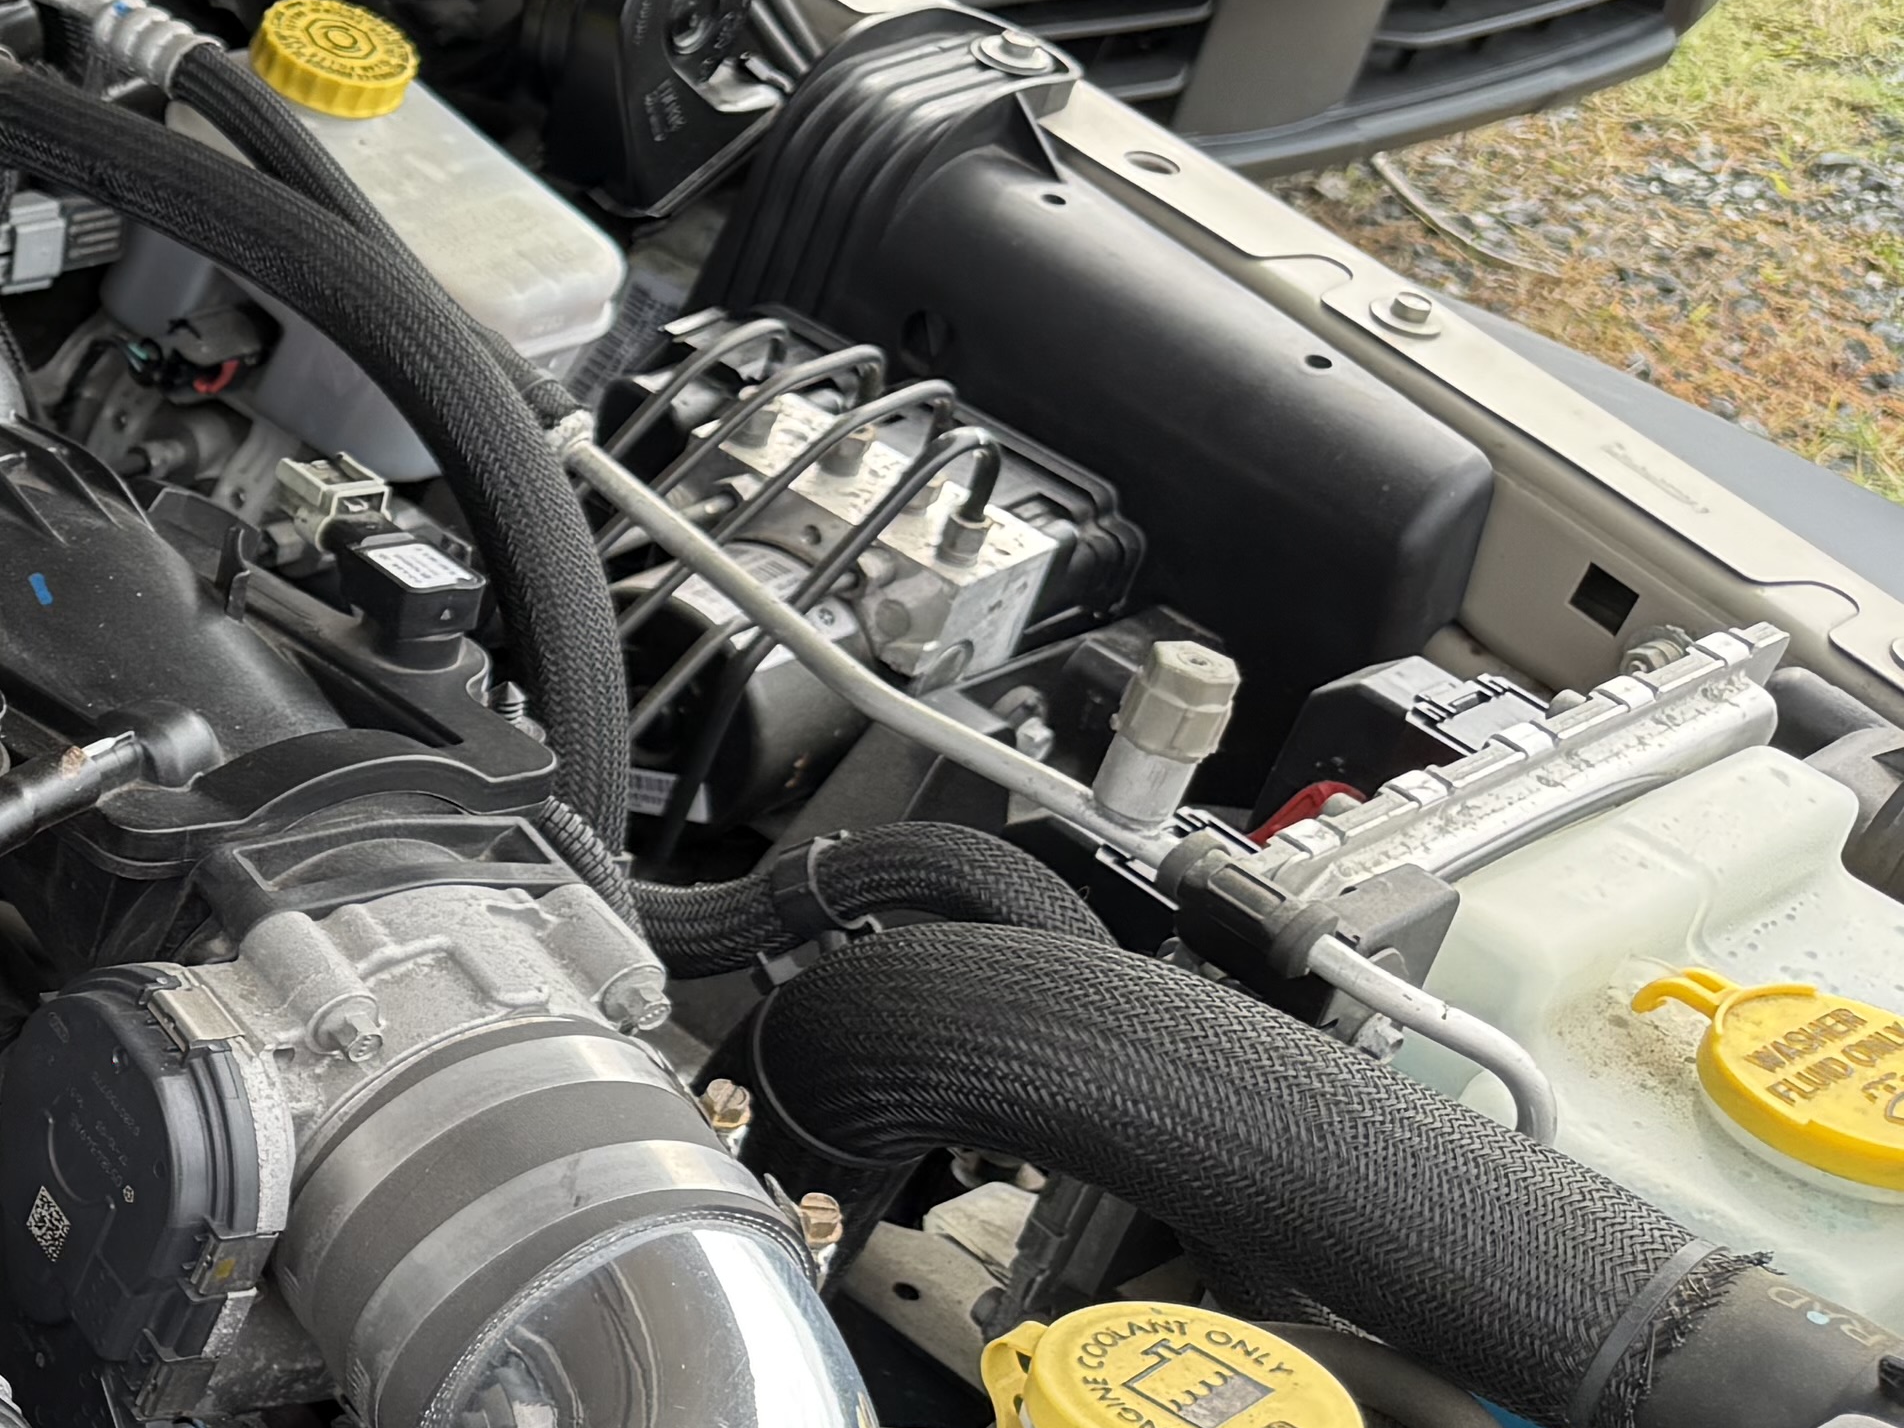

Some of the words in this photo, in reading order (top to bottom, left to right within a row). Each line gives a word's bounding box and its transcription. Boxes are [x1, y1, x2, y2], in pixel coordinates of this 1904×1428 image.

[1744, 1008, 1868, 1073] WASHER
[1765, 1056, 1855, 1107] FLUID
[1077, 1319, 1188, 1370] COOLANT
[1205, 1329, 1294, 1376] ONLY
